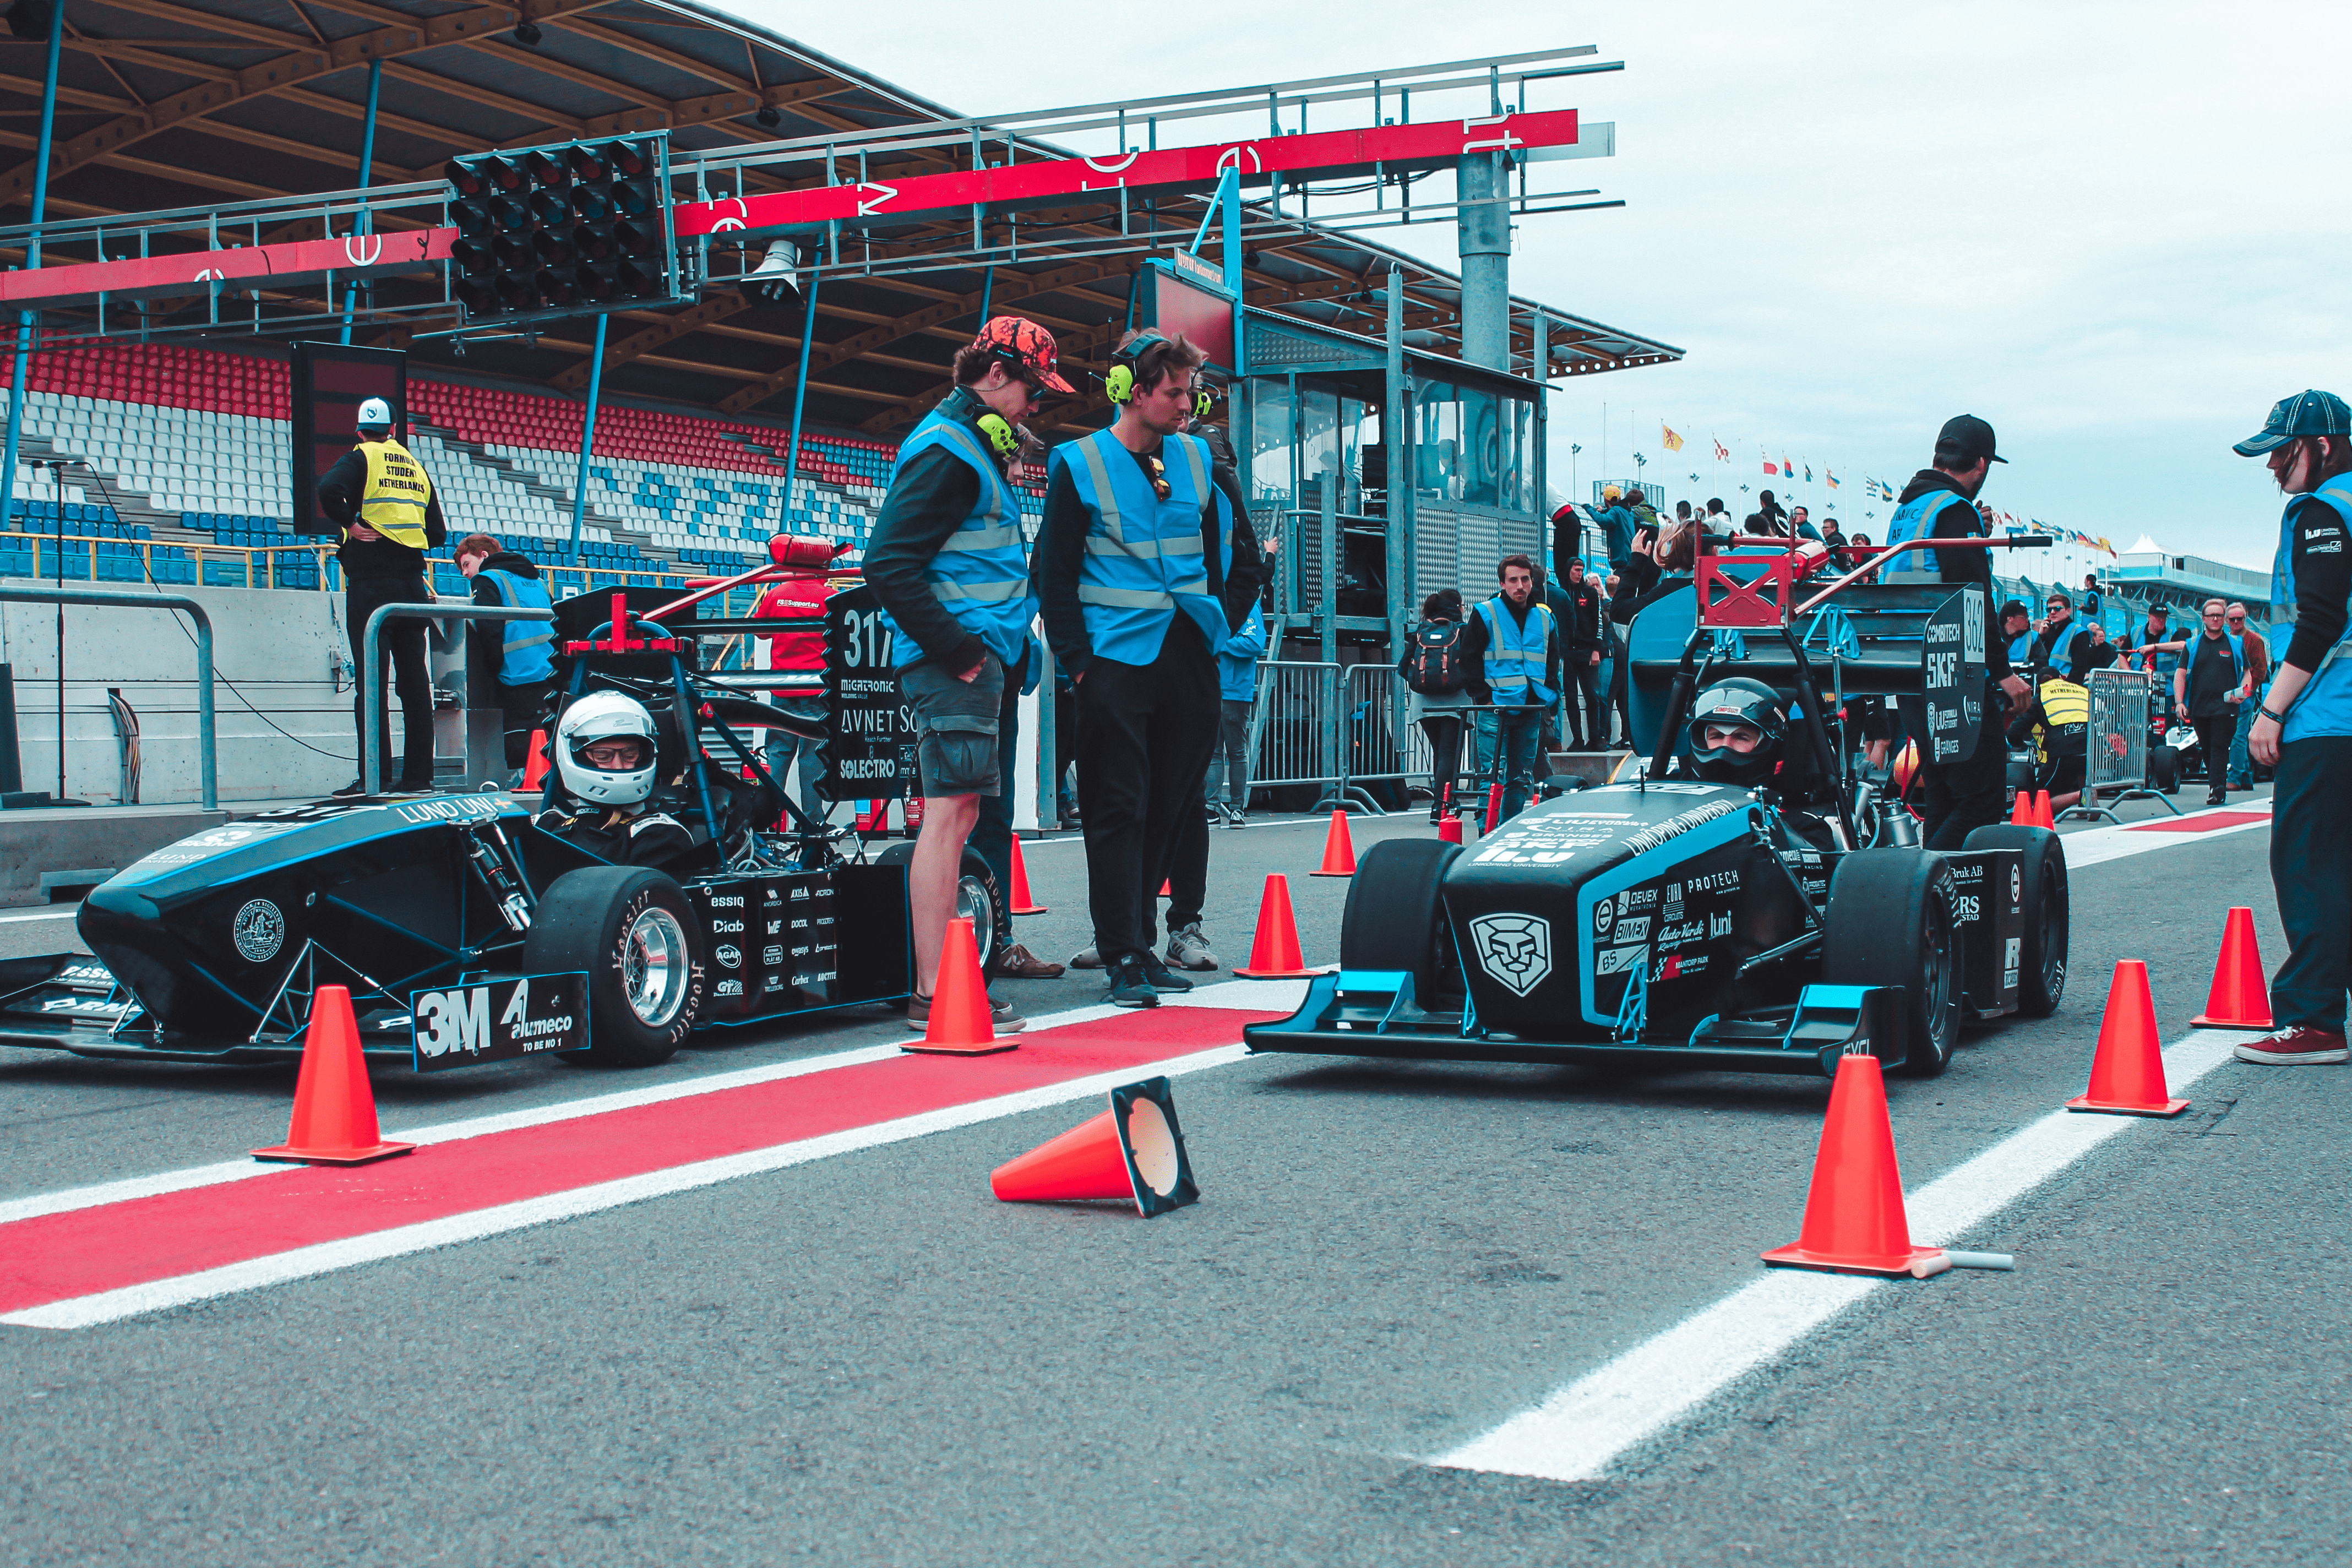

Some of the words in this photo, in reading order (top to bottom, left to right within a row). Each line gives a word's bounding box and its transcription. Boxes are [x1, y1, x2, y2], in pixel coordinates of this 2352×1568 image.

[1927, 623, 1961, 644] COMBITECH
[1965, 596, 1984, 653] 362
[1926, 652, 1957, 689] SKF
[1967, 701, 1981, 714] NIRA
[841, 709, 895, 733] AVNET
[840, 759, 895, 779] SOLECTRO
[256, 805, 388, 817] 317
[396, 802, 459, 823] LUND
[455, 797, 499, 814] UNI
[1620, 818, 1688, 857] LINKÖPING
[1674, 798, 1738, 829] UNIVERSITY
[1485, 841, 1600, 850] SKF
[1687, 869, 1739, 893] PROTECH
[1970, 865, 1983, 877] AB
[791, 888, 803, 899] AXIS
[1630, 889, 1658, 905] DEVEX
[1667, 883, 1682, 903] EURO
[714, 919, 744, 933] Diab
[791, 918, 808, 929] DOCOL
[1615, 920, 1648, 941] BIMEX
[1658, 925, 1681, 942] Auto
[1681, 920, 1705, 938] Verdi
[1602, 950, 1617, 971] BS
[1697, 955, 1709, 965] PARK
[717, 981, 734, 993] GT
[416, 987, 491, 1057] 3M
[510, 1015, 573, 1040] alumeco
[522, 1042, 532, 1053] TO
[533, 1041, 544, 1050] BE
[545, 1039, 556, 1049] NO
[558, 1038, 562, 1047] 1
